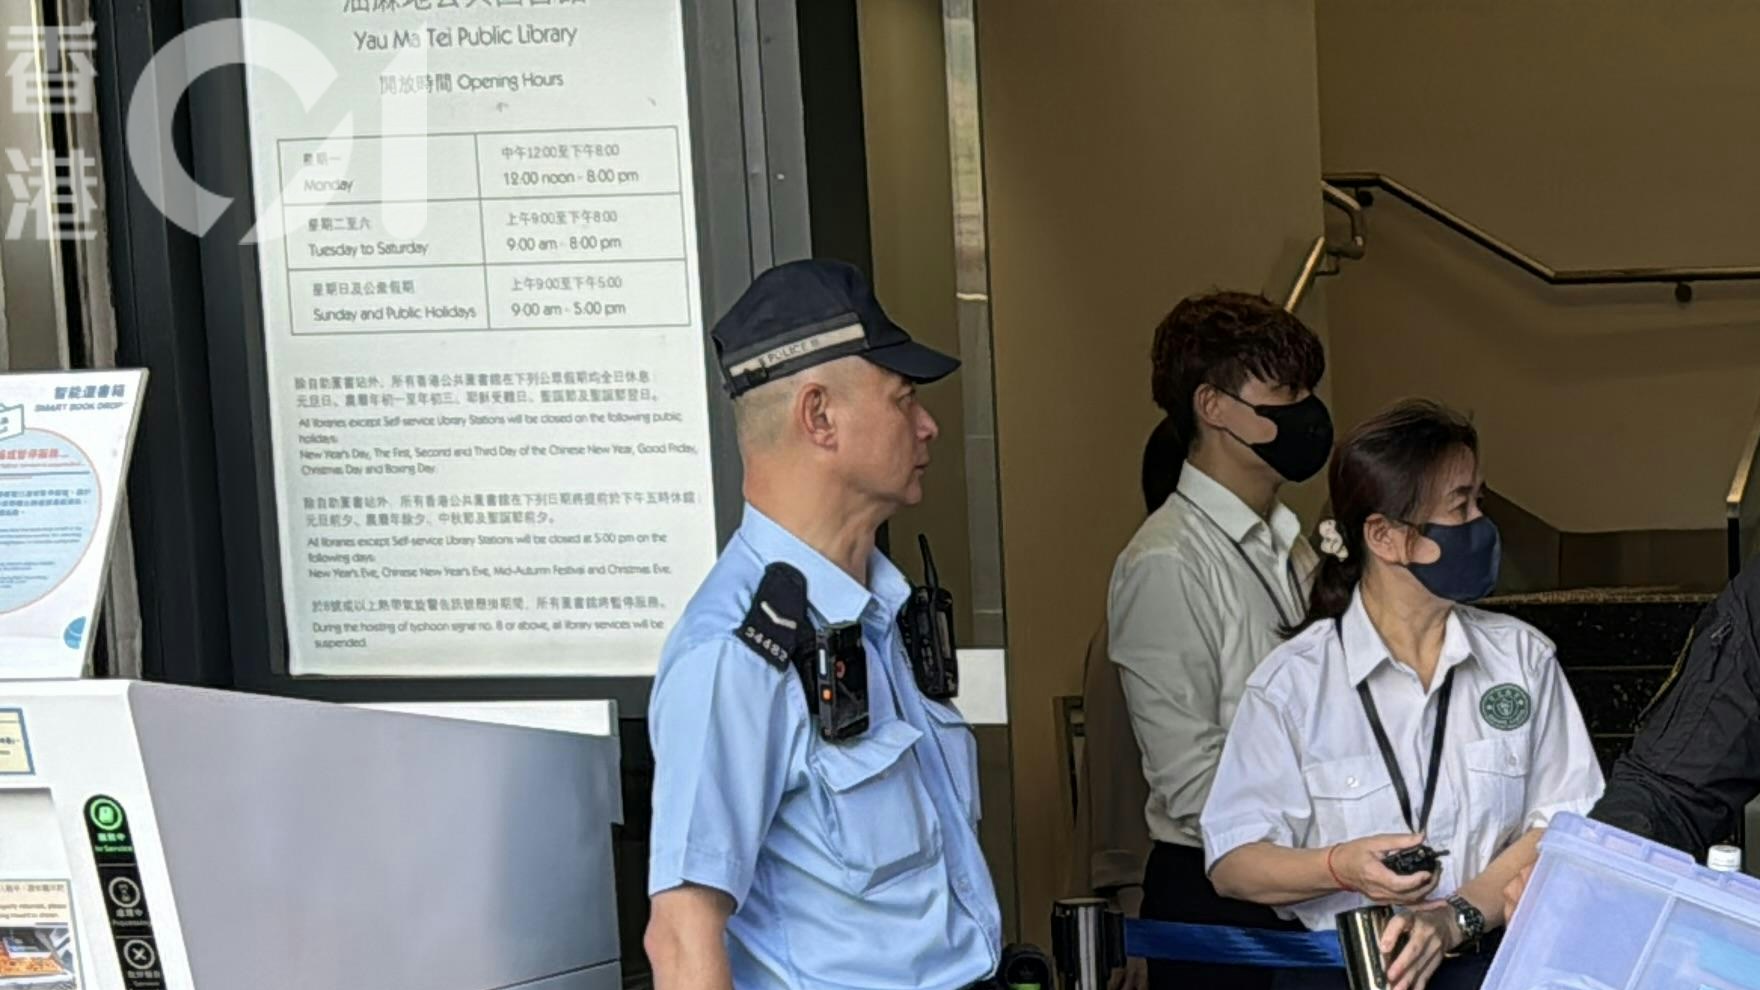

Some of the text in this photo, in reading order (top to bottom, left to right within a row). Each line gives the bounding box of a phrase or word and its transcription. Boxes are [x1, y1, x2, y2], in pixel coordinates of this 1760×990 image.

[352, 23, 578, 50] Yau Ma Tei Public Library
[378, 72, 564, 93] 開放時間 Opening Hours
[500, 143, 620, 159] 中午12:00至下午8:00
[503, 168, 639, 185] 12:00 noon 8:00 pm
[303, 179, 354, 192] Monday
[307, 216, 370, 231] 星期二至六
[505, 209, 618, 225] 上午9:00至下午8:00
[307, 241, 429, 257] Tuesday to Saturday
[505, 235, 622, 251] 9:00 am 8:00 pm
[510, 275, 623, 291] 上午9:00至下午5:00
[312, 305, 477, 321] Sunday and Public Holidays
[510, 300, 626, 316] 9:00 am 5:00 pm
[768, 341, 809, 363] POLICE
